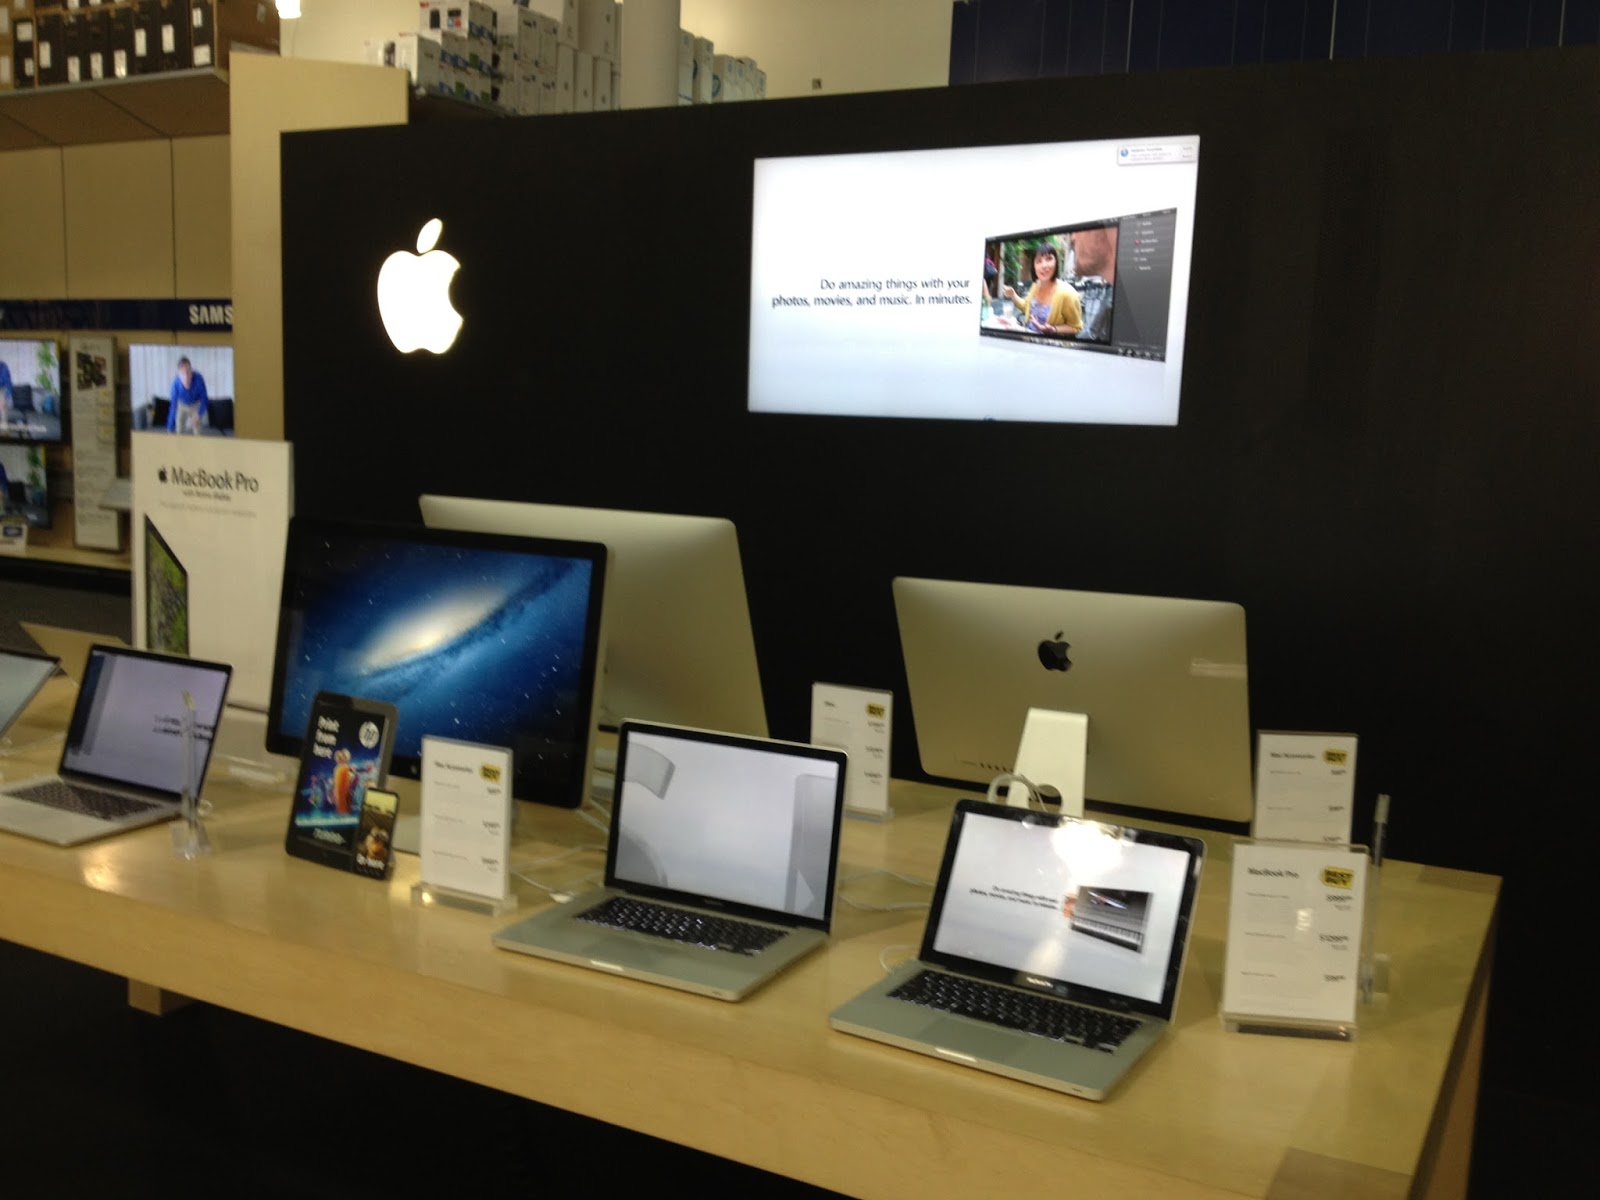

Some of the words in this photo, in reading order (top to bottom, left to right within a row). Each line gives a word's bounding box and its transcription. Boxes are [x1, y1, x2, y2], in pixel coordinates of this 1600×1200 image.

[820, 279, 836, 290] Do
[838, 278, 883, 291] amazing
[886, 278, 918, 290] things
[920, 278, 944, 289] with
[947, 279, 971, 290] your
[772, 294, 811, 308] photos,
[813, 295, 853, 307] movies,
[856, 294, 877, 306] and
[914, 294, 925, 305] In
[928, 293, 973, 305] minutes.
[171, 466, 233, 490] MacBook
[235, 471, 260, 493] Pro
[1325, 869, 1353, 878] BEST
